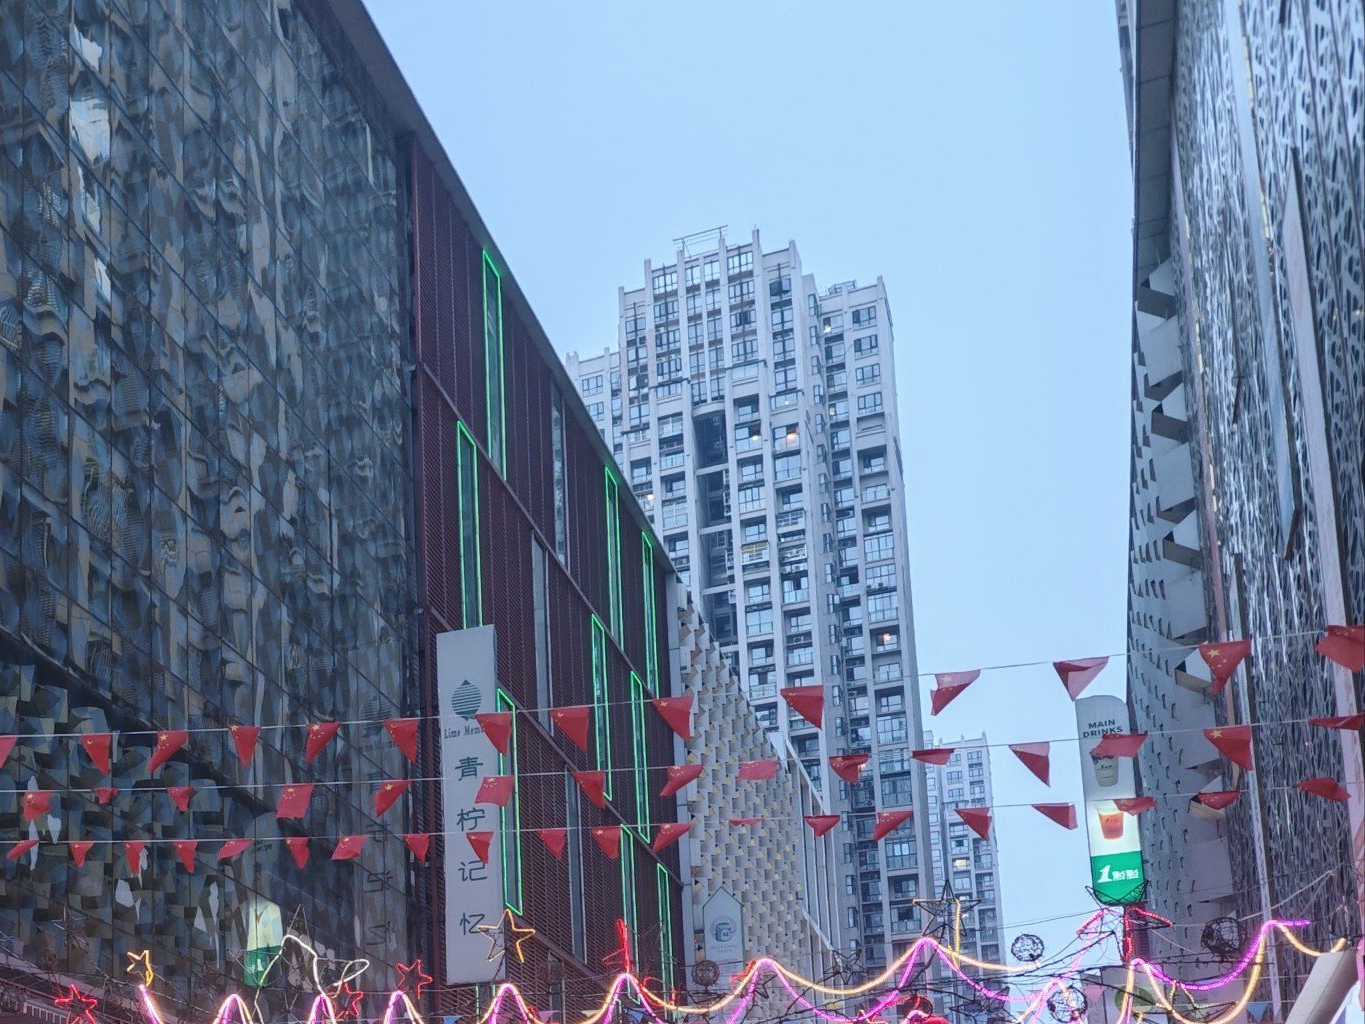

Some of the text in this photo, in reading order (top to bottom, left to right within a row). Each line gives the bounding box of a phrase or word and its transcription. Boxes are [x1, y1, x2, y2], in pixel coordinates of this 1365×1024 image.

[1088, 719, 1116, 730] MAIN
[444, 725, 462, 739] Lime
[1083, 726, 1123, 738] DRINKS
[454, 756, 492, 936] 青柠记忆
